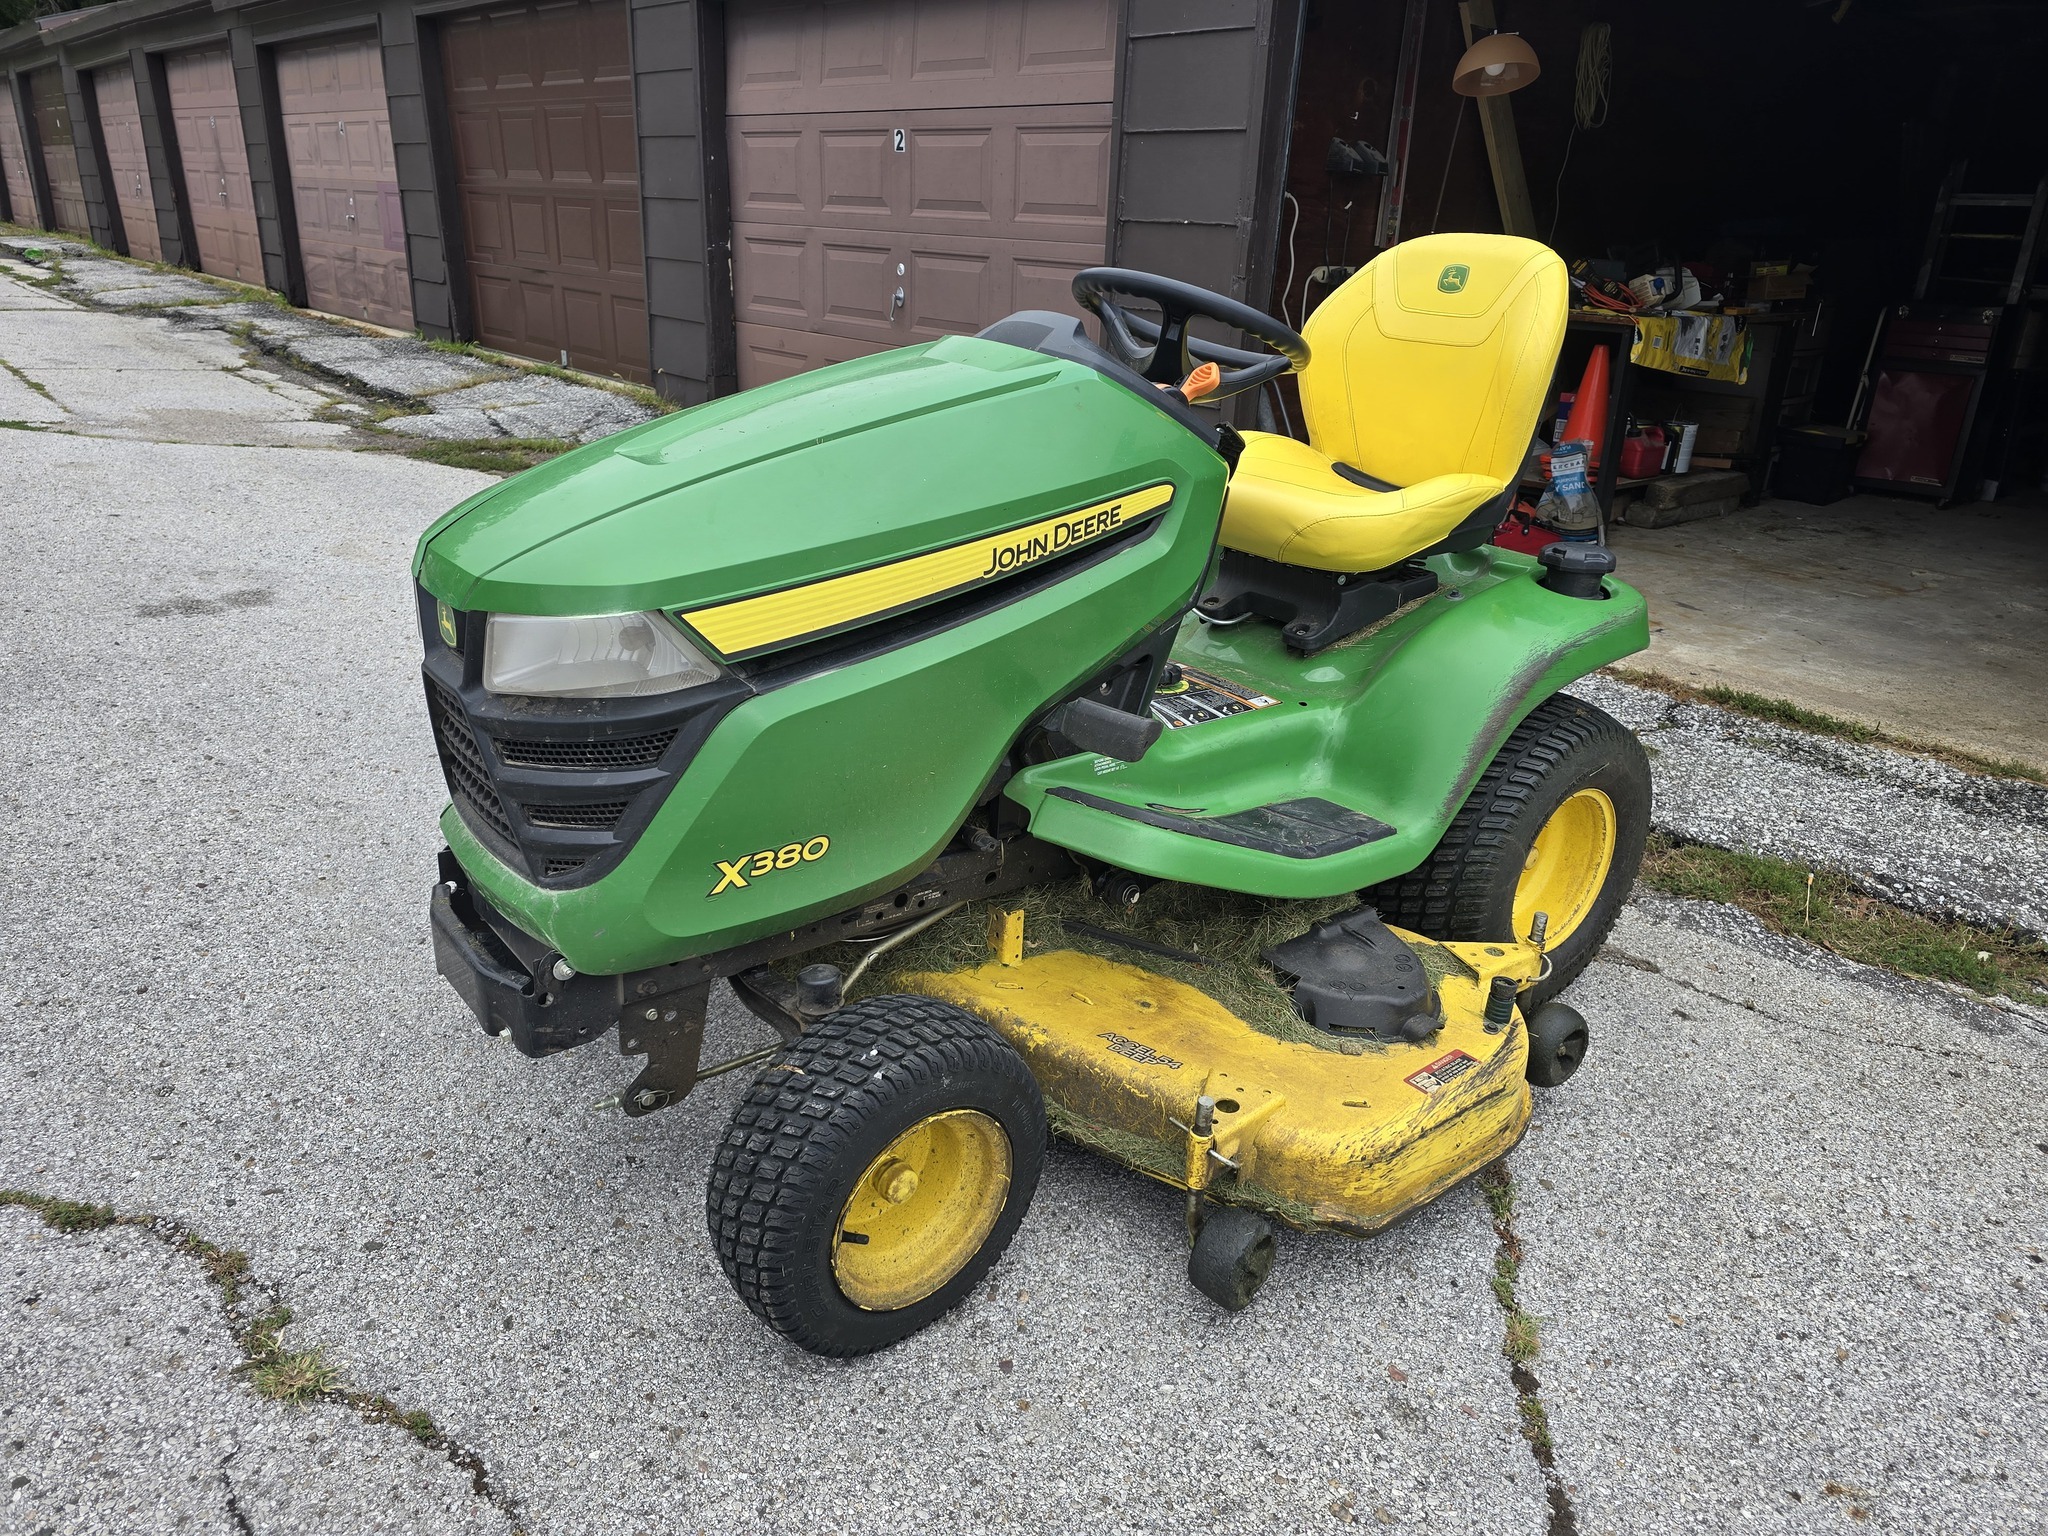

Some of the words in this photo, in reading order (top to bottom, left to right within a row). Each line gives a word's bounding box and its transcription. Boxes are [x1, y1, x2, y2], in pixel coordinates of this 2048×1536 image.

[895, 129, 904, 151] 2
[983, 533, 1049, 579] JOHN
[1053, 504, 1123, 551] DEERE
[705, 834, 831, 899] X380
[1096, 1032, 1156, 1059] ACCEL
[1106, 1043, 1160, 1065] DEEP
